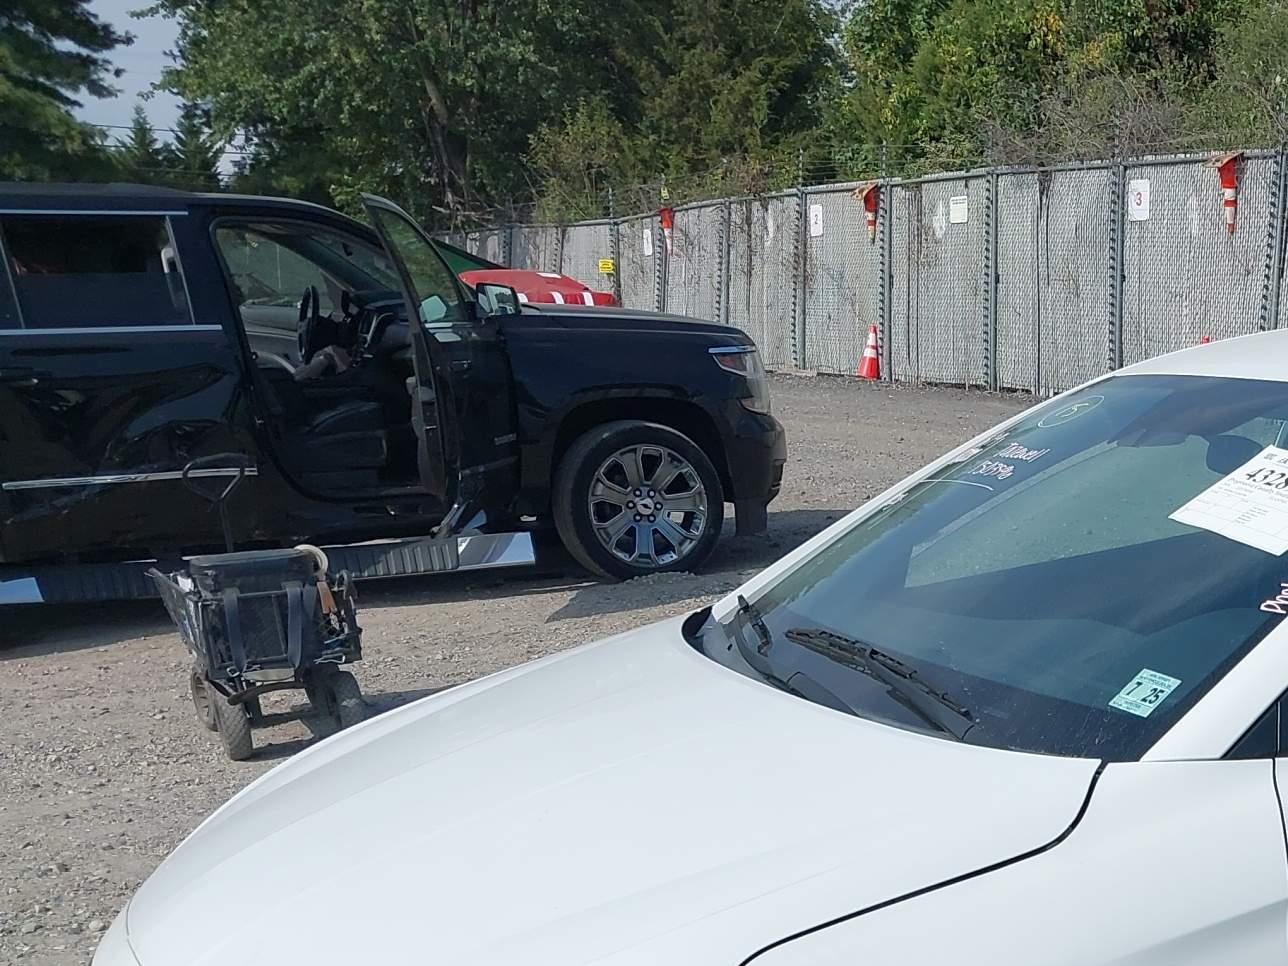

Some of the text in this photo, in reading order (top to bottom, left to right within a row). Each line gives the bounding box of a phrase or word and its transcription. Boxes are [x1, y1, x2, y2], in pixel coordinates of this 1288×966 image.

[1135, 191, 1143, 207] 3
[1126, 681, 1143, 696] 7
[1140, 687, 1165, 704] 25
